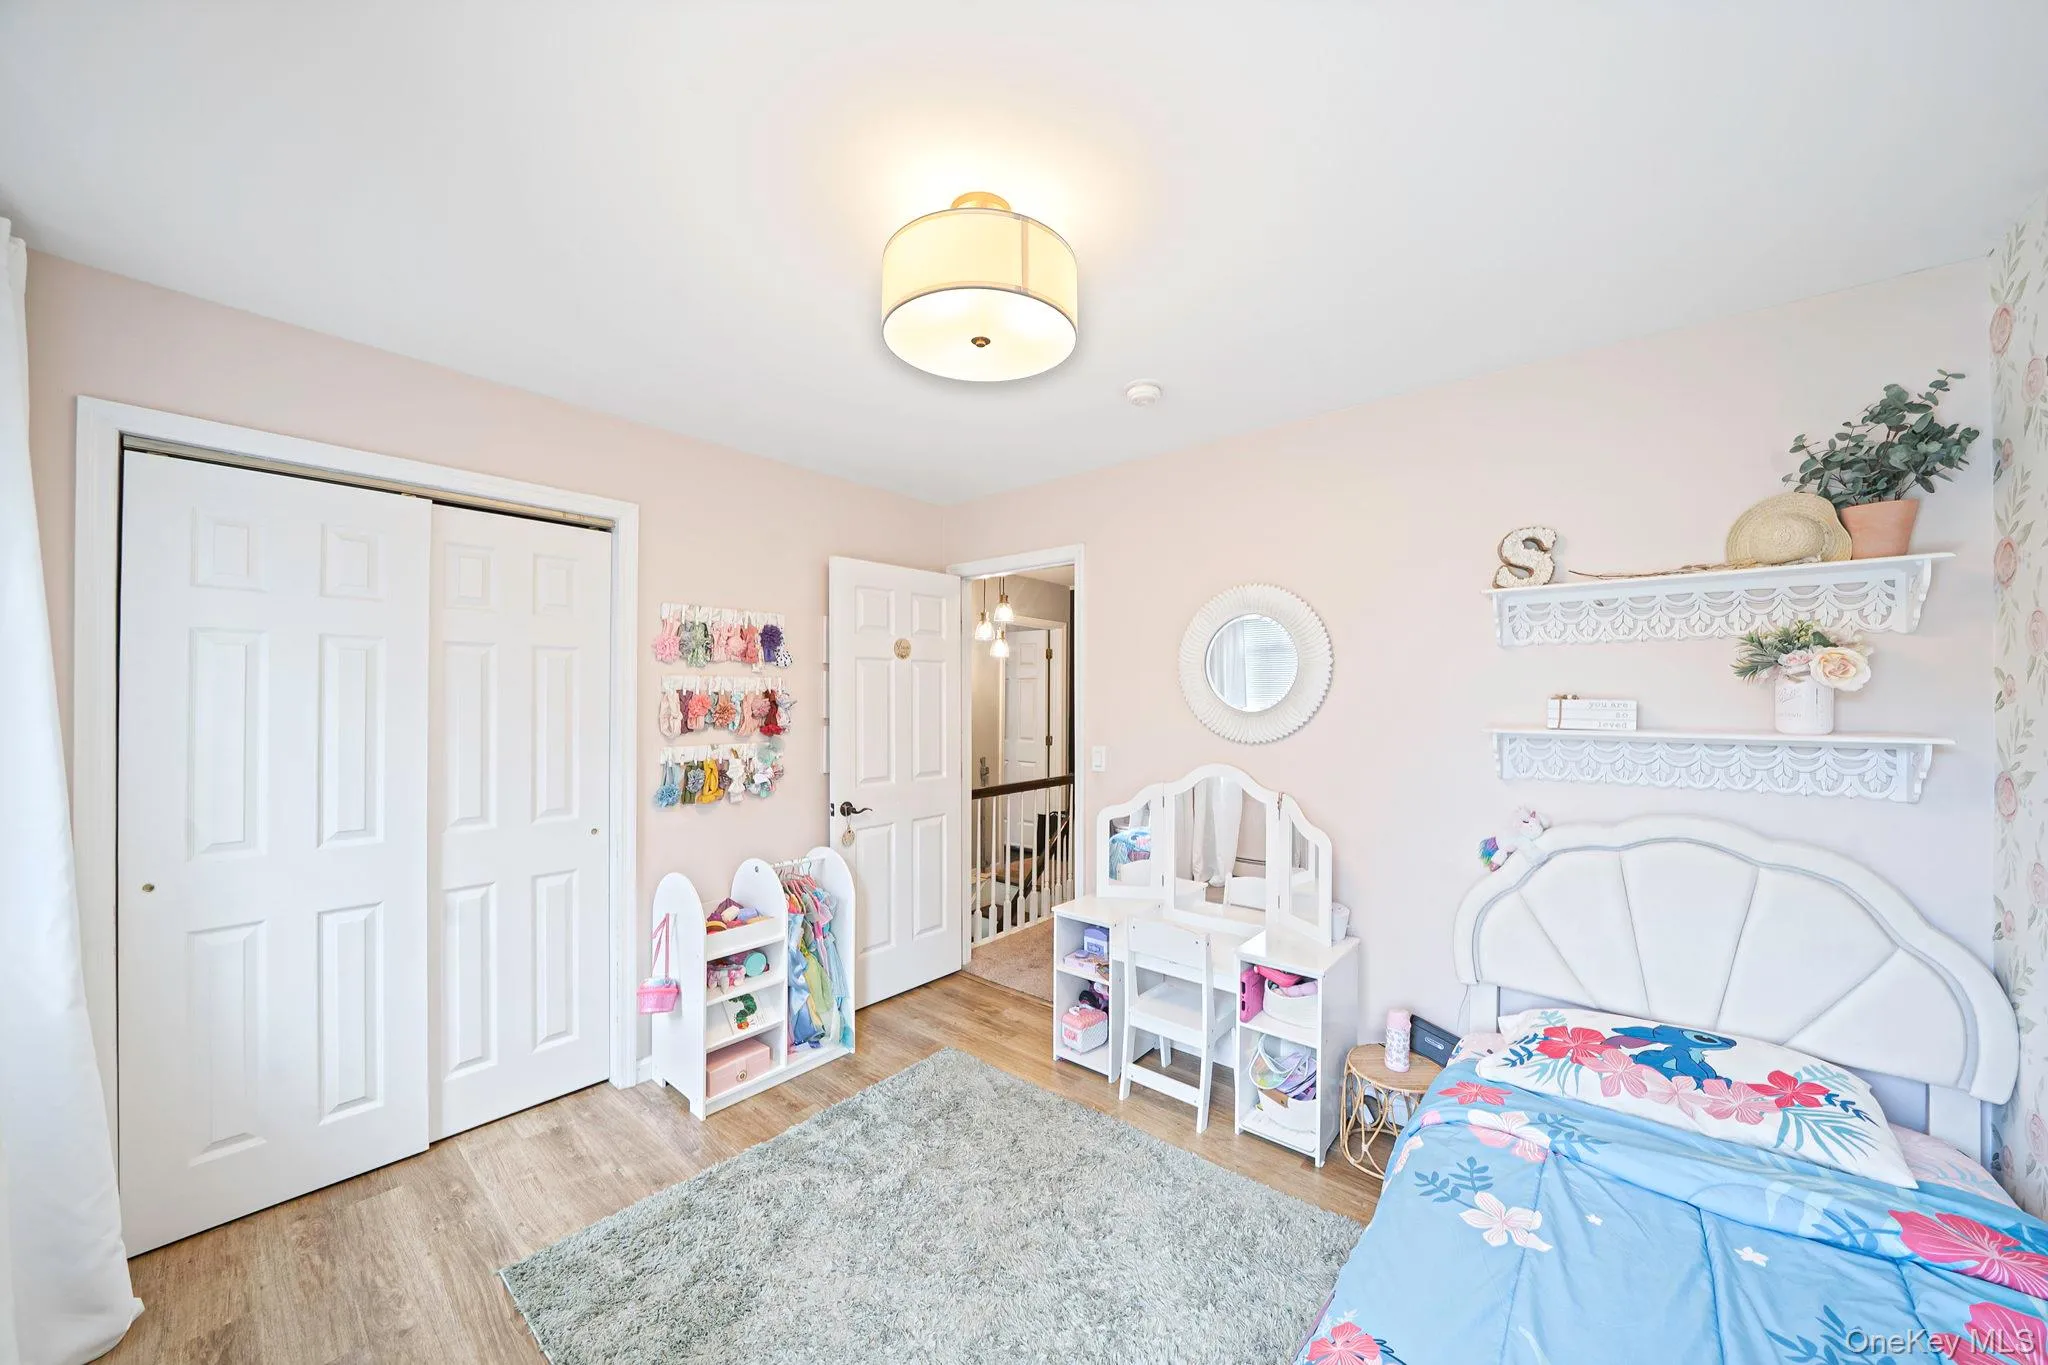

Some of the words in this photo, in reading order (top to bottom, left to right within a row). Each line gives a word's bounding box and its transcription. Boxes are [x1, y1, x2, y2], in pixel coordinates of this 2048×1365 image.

[1492, 526, 1557, 589] S
[1588, 701, 1607, 710] you
[1598, 721, 1628, 729] loved
